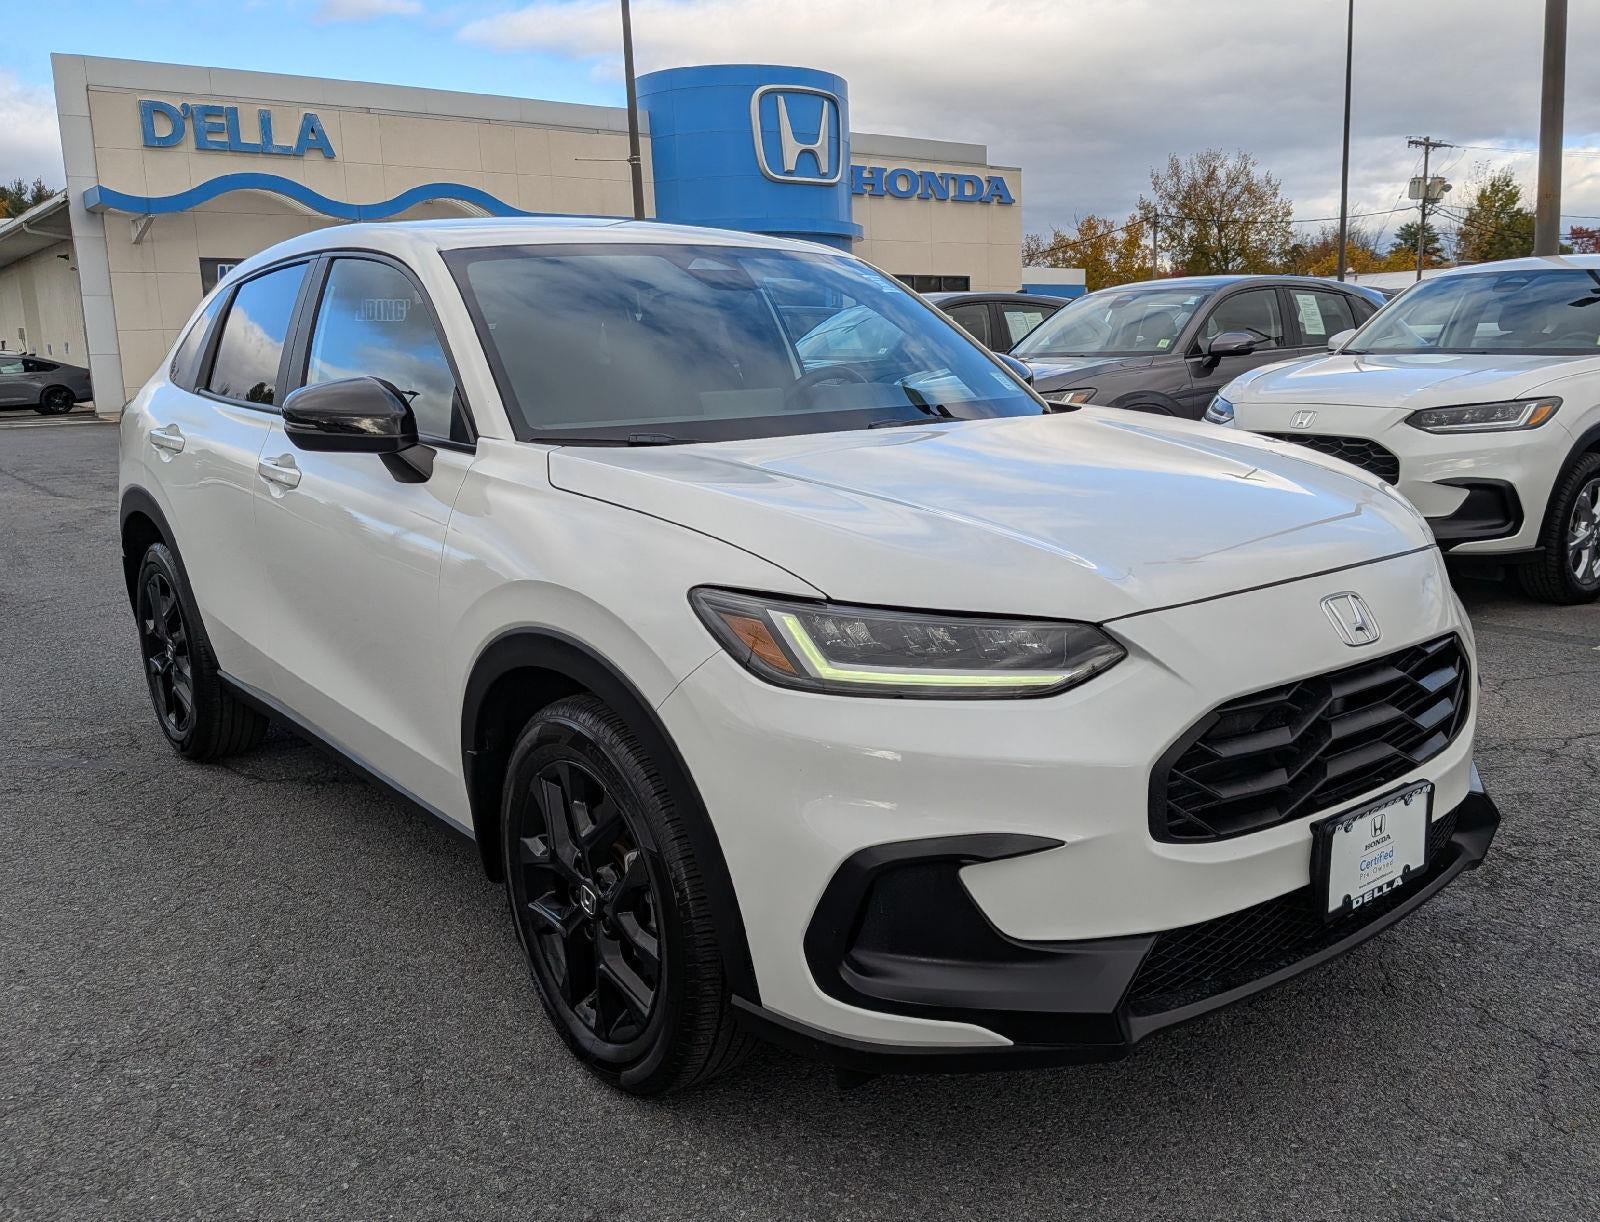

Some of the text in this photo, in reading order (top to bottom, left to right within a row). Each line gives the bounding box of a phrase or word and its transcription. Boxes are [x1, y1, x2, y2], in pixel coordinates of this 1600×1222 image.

[139, 99, 337, 159] D'ELLA
[850, 163, 1016, 206] HONDA
[1360, 846, 1394, 872] Certified
[1364, 834, 1391, 851] HONDA
[1352, 876, 1403, 909] DELLA
